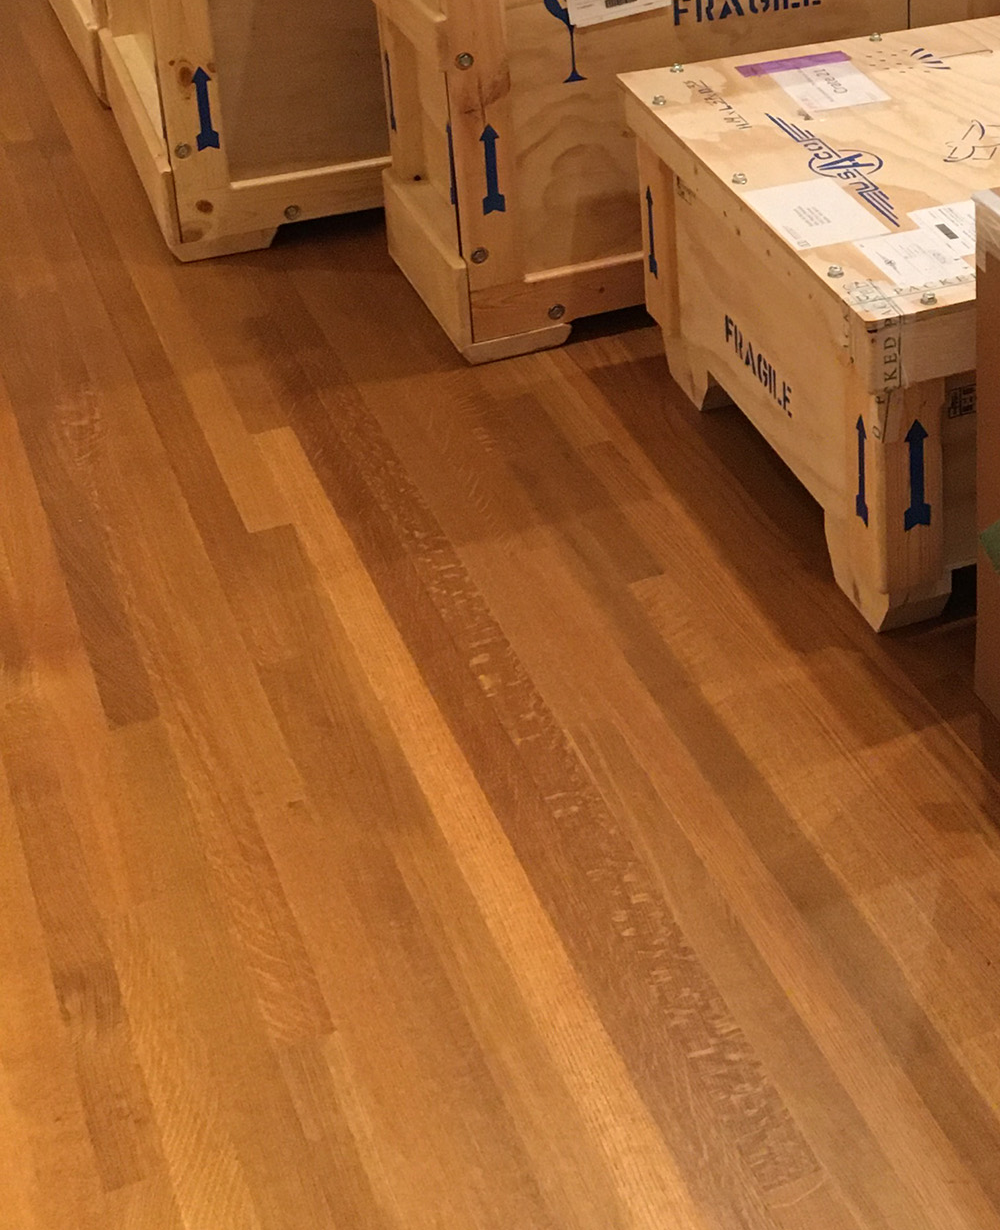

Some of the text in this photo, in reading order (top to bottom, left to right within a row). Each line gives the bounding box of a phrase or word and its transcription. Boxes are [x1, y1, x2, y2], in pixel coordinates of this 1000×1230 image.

[813, 68, 830, 77] 21
[826, 76, 848, 95] Crate
[724, 314, 793, 419] FRAGILE
